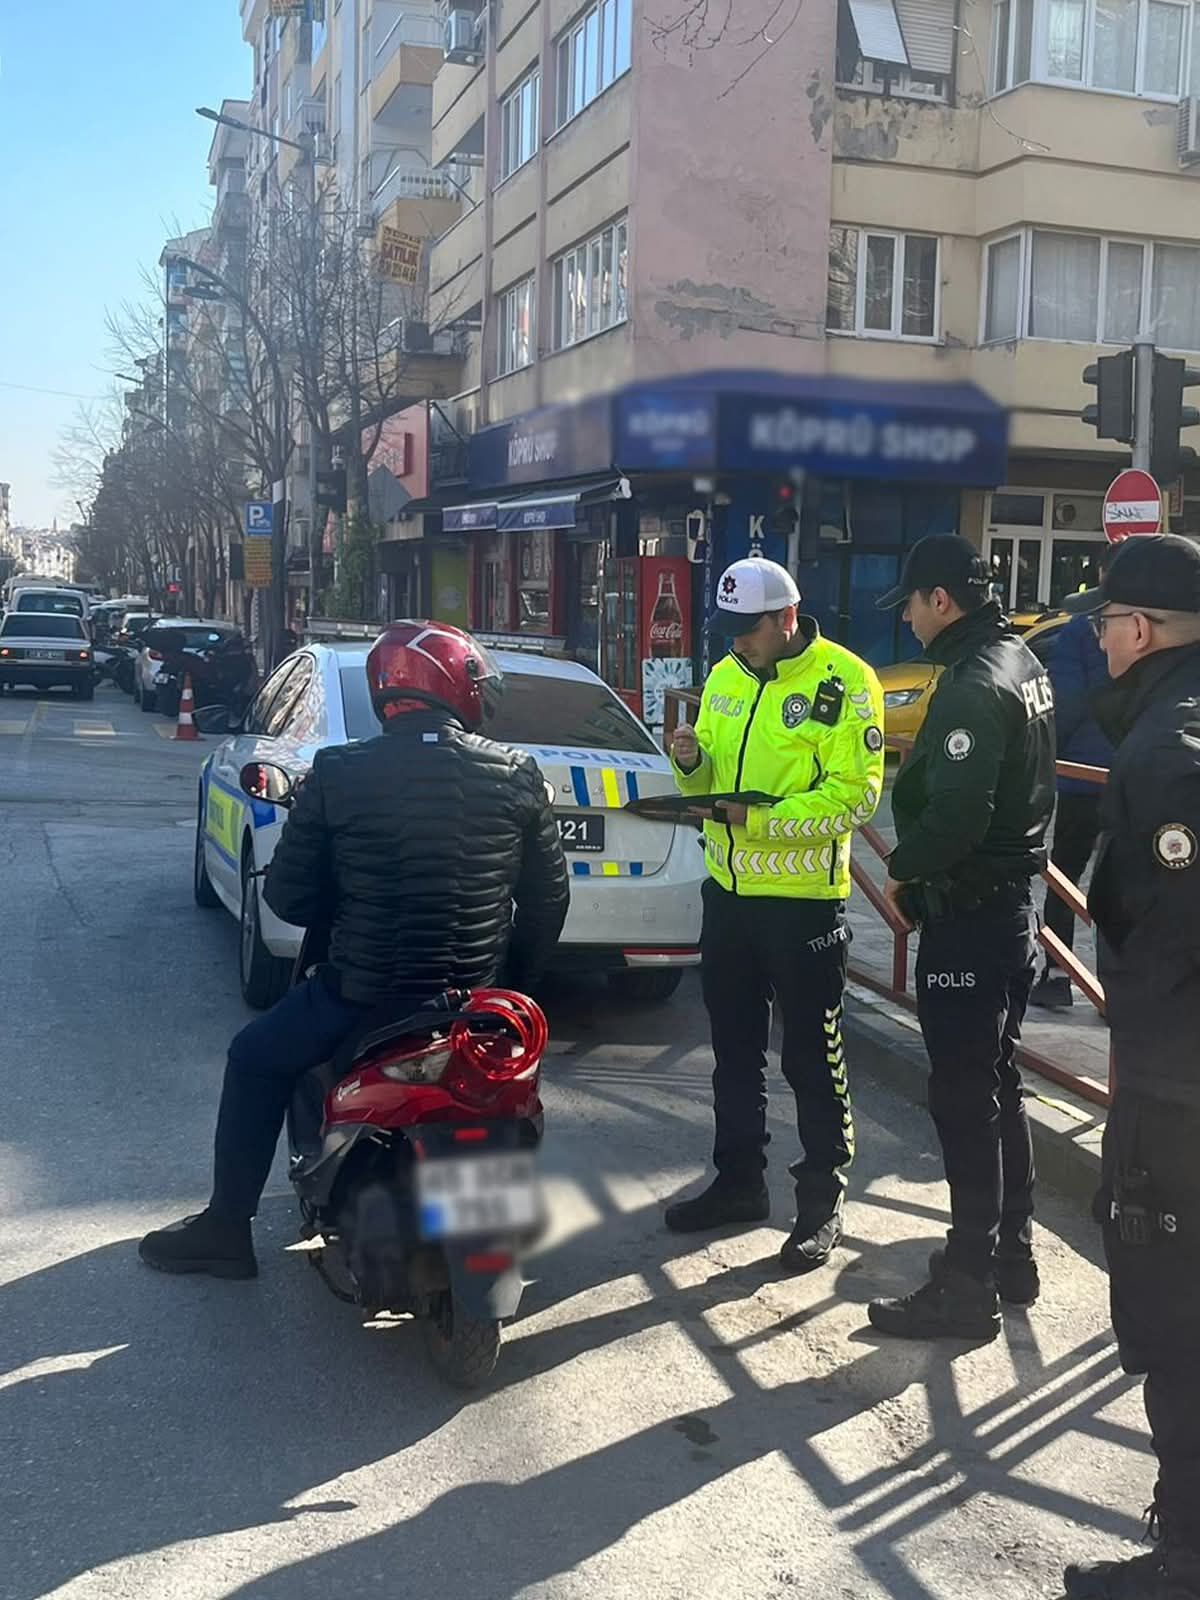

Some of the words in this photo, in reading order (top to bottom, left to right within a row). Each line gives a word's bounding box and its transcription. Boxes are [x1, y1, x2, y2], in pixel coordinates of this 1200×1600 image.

[752, 408, 872, 456] KÖPRÜ
[880, 422, 976, 463] SHOP
[249, 505, 264, 527] P
